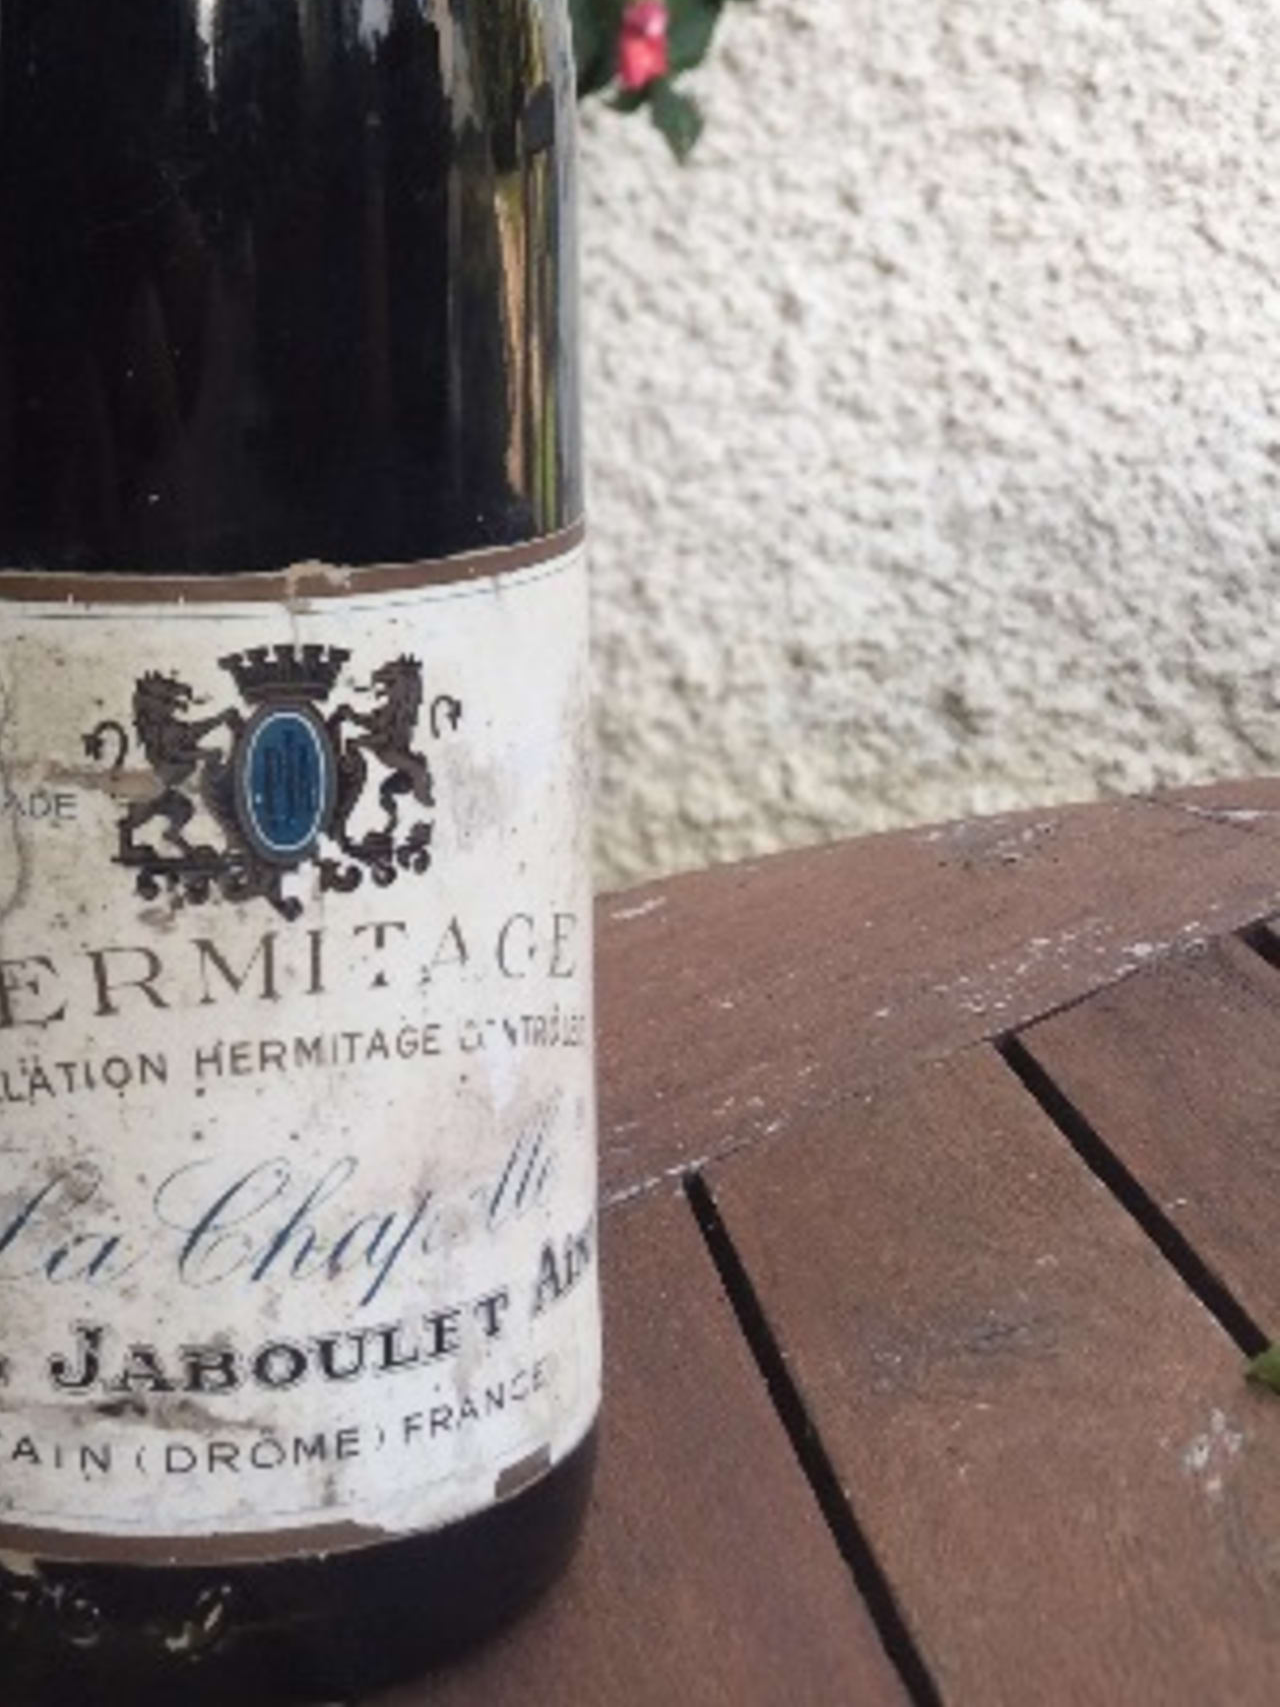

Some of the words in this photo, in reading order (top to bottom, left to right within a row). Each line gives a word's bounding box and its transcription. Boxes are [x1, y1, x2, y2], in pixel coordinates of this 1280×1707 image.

[195, 1022, 442, 1083] HERMITAGE
[50, 1284, 510, 1397] JABOULET
[402, 1356, 549, 1446] FRANCE
